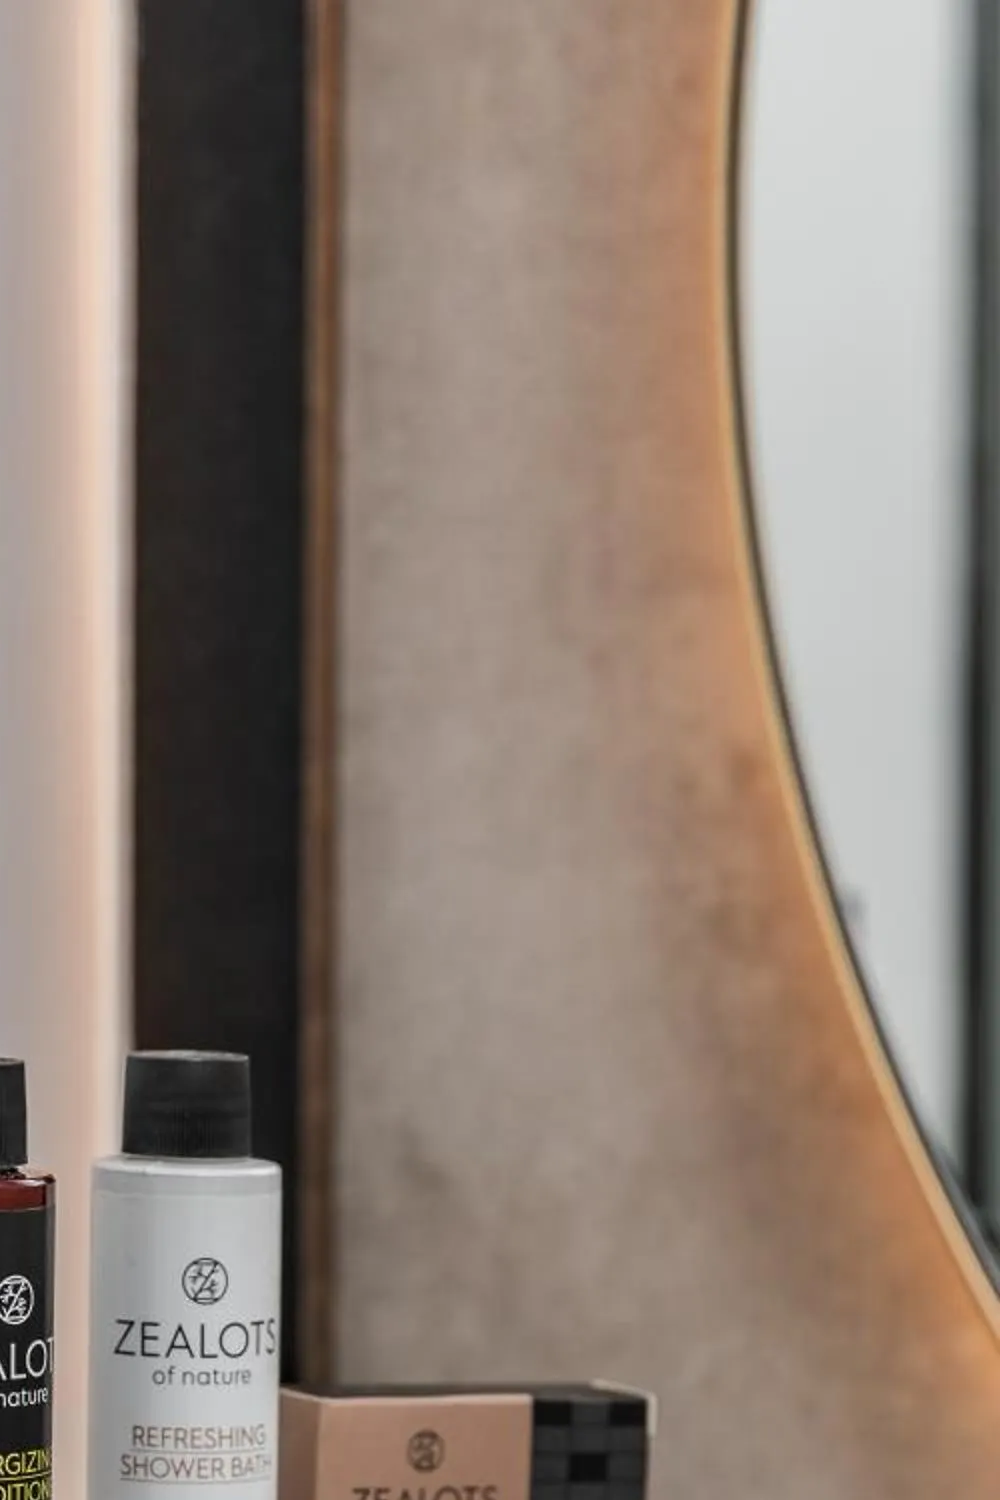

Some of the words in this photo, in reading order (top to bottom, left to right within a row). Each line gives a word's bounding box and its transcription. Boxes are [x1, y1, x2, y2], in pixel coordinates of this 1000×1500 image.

[113, 1317, 276, 1359] ZEALOTS
[152, 1365, 176, 1386] of
[181, 1368, 252, 1386] nature
[132, 1424, 266, 1451] REFRESHING
[120, 1453, 226, 1479] SHOWER
[231, 1454, 272, 1478] BATH
